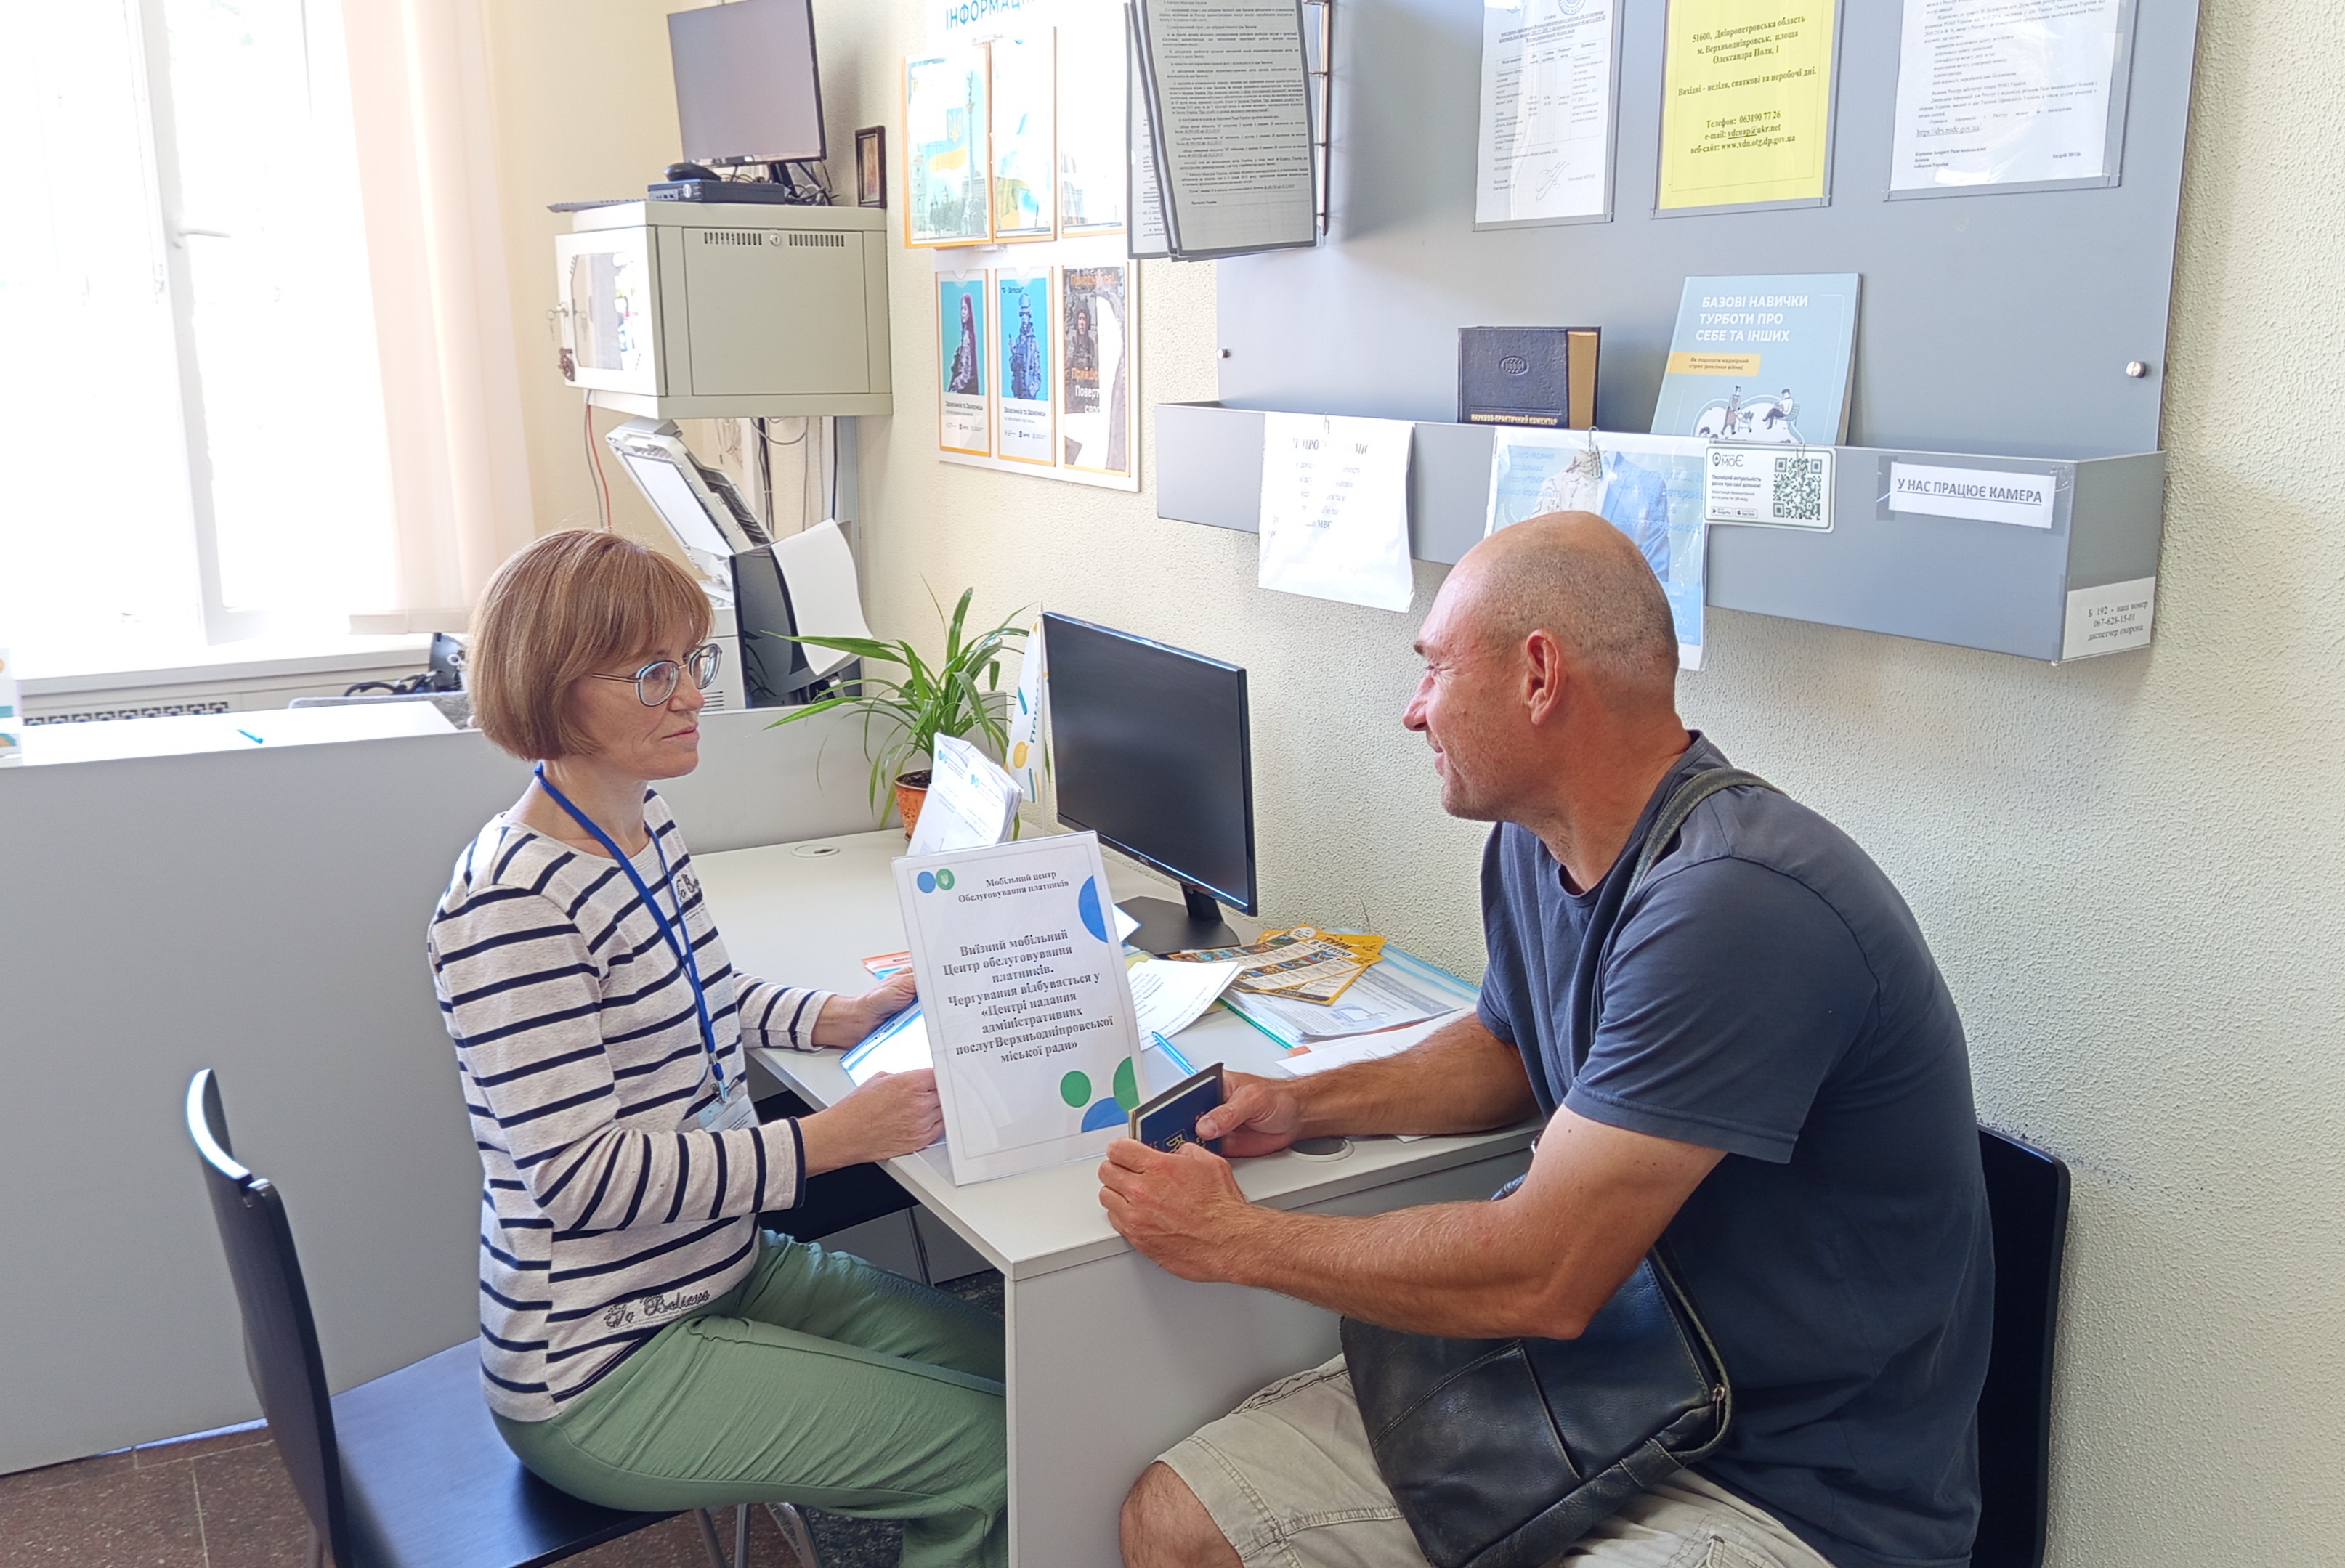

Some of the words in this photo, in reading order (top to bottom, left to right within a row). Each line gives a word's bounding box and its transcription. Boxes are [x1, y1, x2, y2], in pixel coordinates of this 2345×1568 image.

[946, 0, 1034, 30] ІНФОРМАЦ
[1692, 32, 1712, 42] 51600,
[1778, 16, 1805, 26] область
[1775, 31, 1798, 41] площа
[1712, 51, 1753, 64] Олександра
[1754, 47, 1774, 57] Поля,
[1678, 85, 1701, 97] Вихідні
[1707, 80, 1730, 92] неділя,
[1731, 75, 1760, 88] святкові
[1771, 69, 1802, 82] неробочі
[1803, 66, 1817, 77] дні.
[1706, 118, 1736, 129] Телефон:
[1739, 113, 1762, 123] 063190
[1763, 112, 1772, 121] 77
[1773, 110, 1781, 119] 26
[1704, 130, 1726, 140] e-mail:
[1690, 144, 1720, 154] веб-сайт:
[1701, 296, 1746, 308] БАЗОВІ
[1749, 295, 1808, 307] НАВИЧКИ
[1699, 313, 1754, 325] ТУРБОТИ
[1757, 313, 1783, 325] ПРО
[1696, 330, 1726, 341] СЕБЕ
[1730, 330, 1744, 341] ТА
[1747, 330, 1790, 341] ІНШИХ
[1075, 385, 1100, 400] Поверт
[1470, 413, 1528, 424] НАУКОВО-ПРАКТИЧНИЙ
[1529, 417, 1558, 426] КОМЕНТАР
[1898, 478, 1905, 490] У
[1908, 479, 1931, 492] НАС
[1934, 482, 1986, 497] ПРАЦЮЄ
[1989, 487, 2042, 503] КАМЕРА
[2097, 606, 2108, 615] 192
[986, 874, 1032, 887] Мобільний
[1033, 872, 1057, 881] центр
[958, 887, 1026, 903] Обслуговування
[1028, 880, 1069, 893] платників
[960, 940, 1006, 957] Виїзний
[1009, 930, 1069, 948] мобільний
[1322, 937, 1353, 949] ТУРИ
[943, 962, 980, 975] Центр
[983, 946, 1073, 969] обслуговування
[992, 965, 1054, 983] платників.
[948, 986, 1018, 1007] Чергування
[1020, 974, 1092, 994] відбувається
[1093, 972, 1100, 983] у
[981, 999, 1027, 1017] «Центрі
[1030, 992, 1077, 1010] надання
[982, 1007, 1082, 1034] адміністративних
[956, 1015, 1114, 1055] послугВерхньодніпровської
[1000, 1045, 1043, 1063] міської
[1045, 1041, 1077, 1057] ради»
